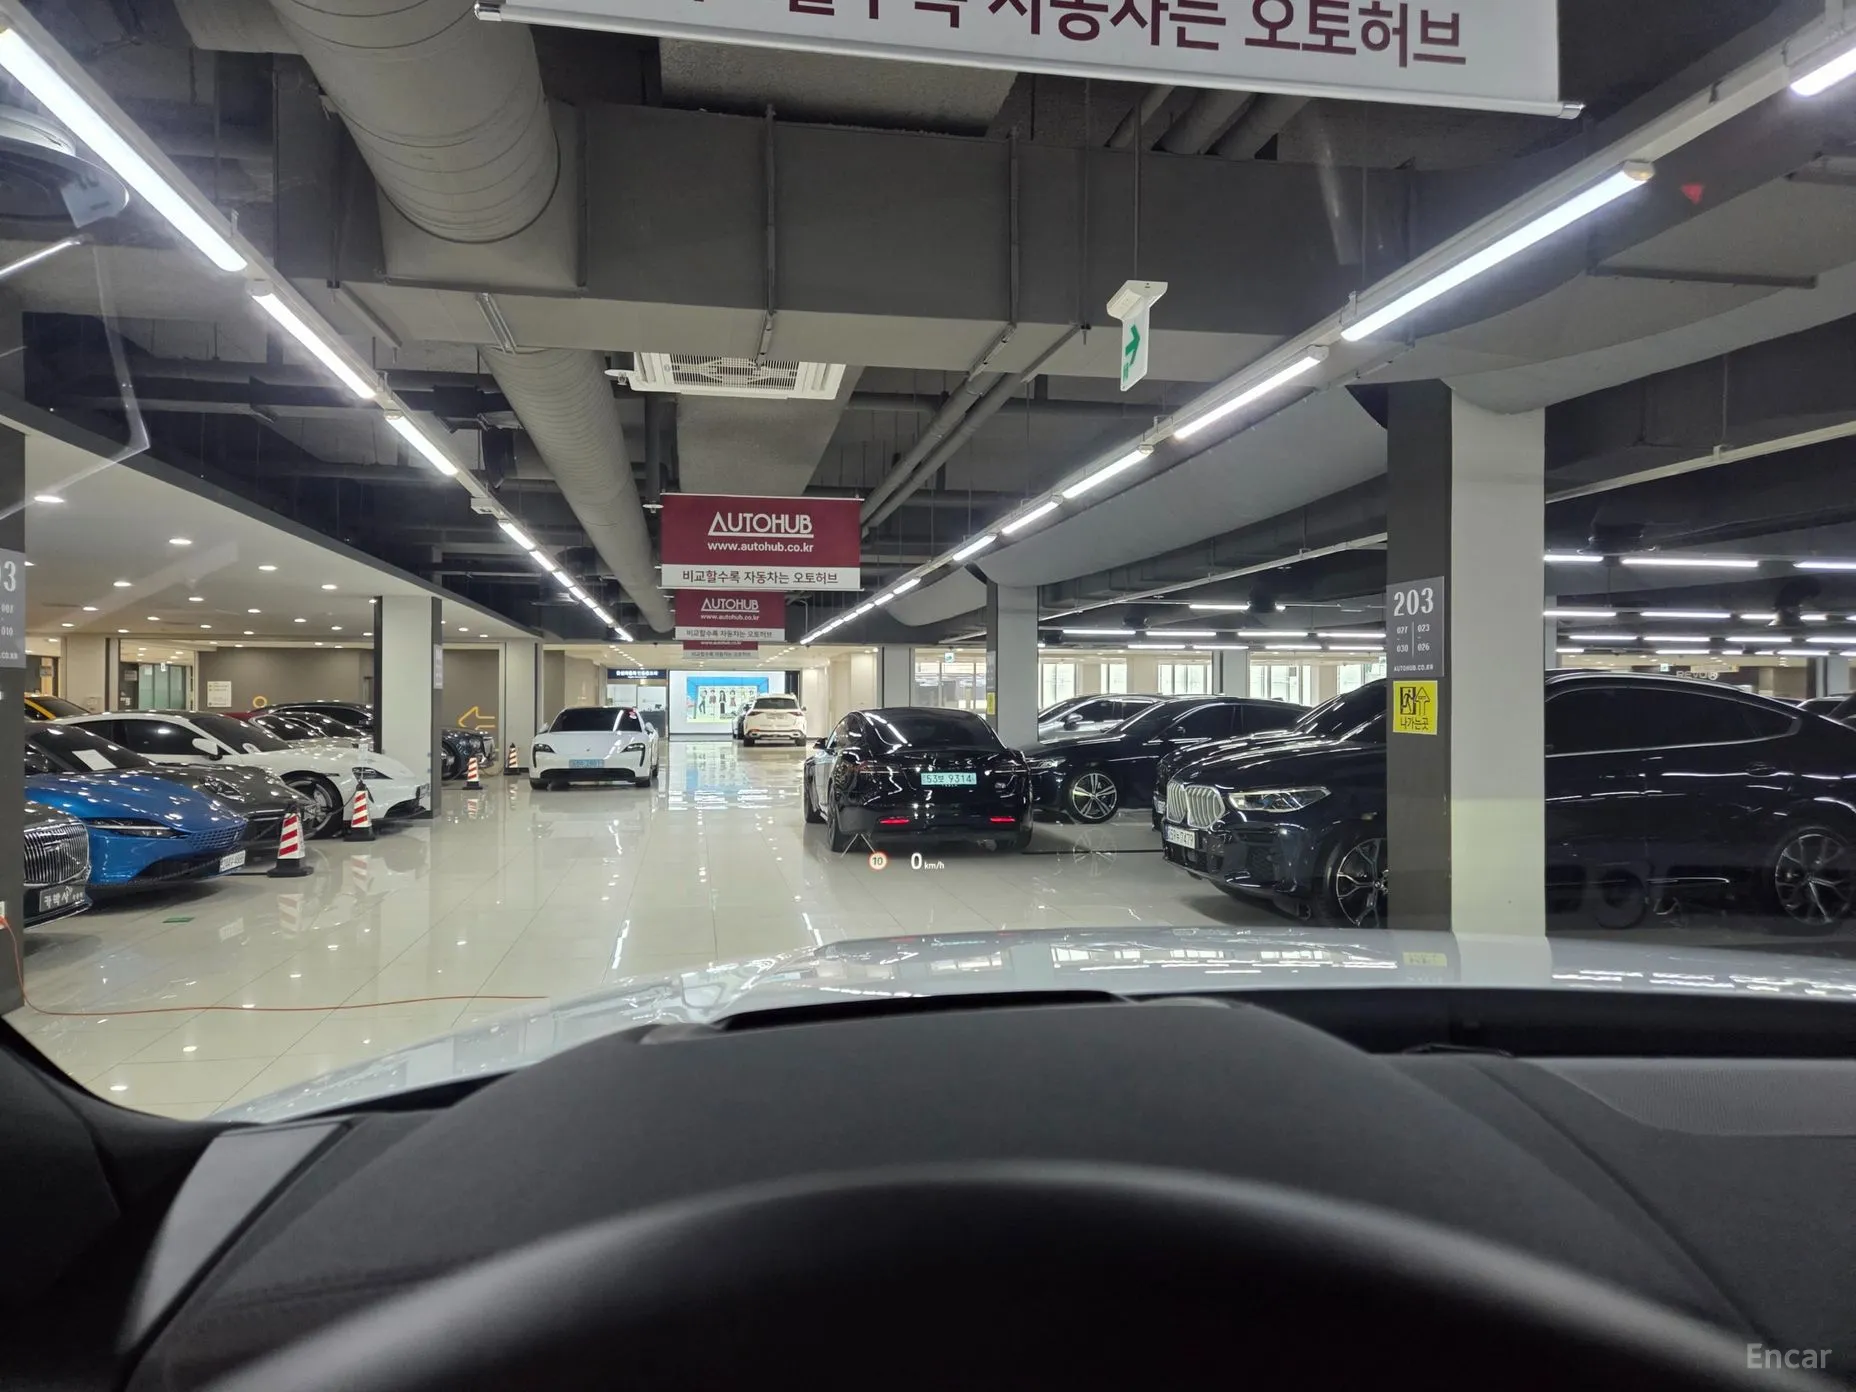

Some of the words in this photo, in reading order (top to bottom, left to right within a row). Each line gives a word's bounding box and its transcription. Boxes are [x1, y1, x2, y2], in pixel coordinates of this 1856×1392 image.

[1244, 0, 1467, 68] 오토허브
[708, 511, 814, 538] AUTOHUB
[708, 542, 814, 553] www.autohub.co.kr
[0, 561, 16, 592] 3
[682, 570, 740, 584] 비교할수록
[744, 571, 790, 584] 자동차는
[793, 572, 839, 585] 오토허브
[701, 597, 760, 613] AUTOHUB
[1393, 587, 1435, 617] 203
[1417, 623, 1431, 633] 023
[949, 774, 972, 783] 9314
[872, 857, 884, 866] 10
[910, 852, 923, 870] 0
[924, 861, 945, 870] km/h
